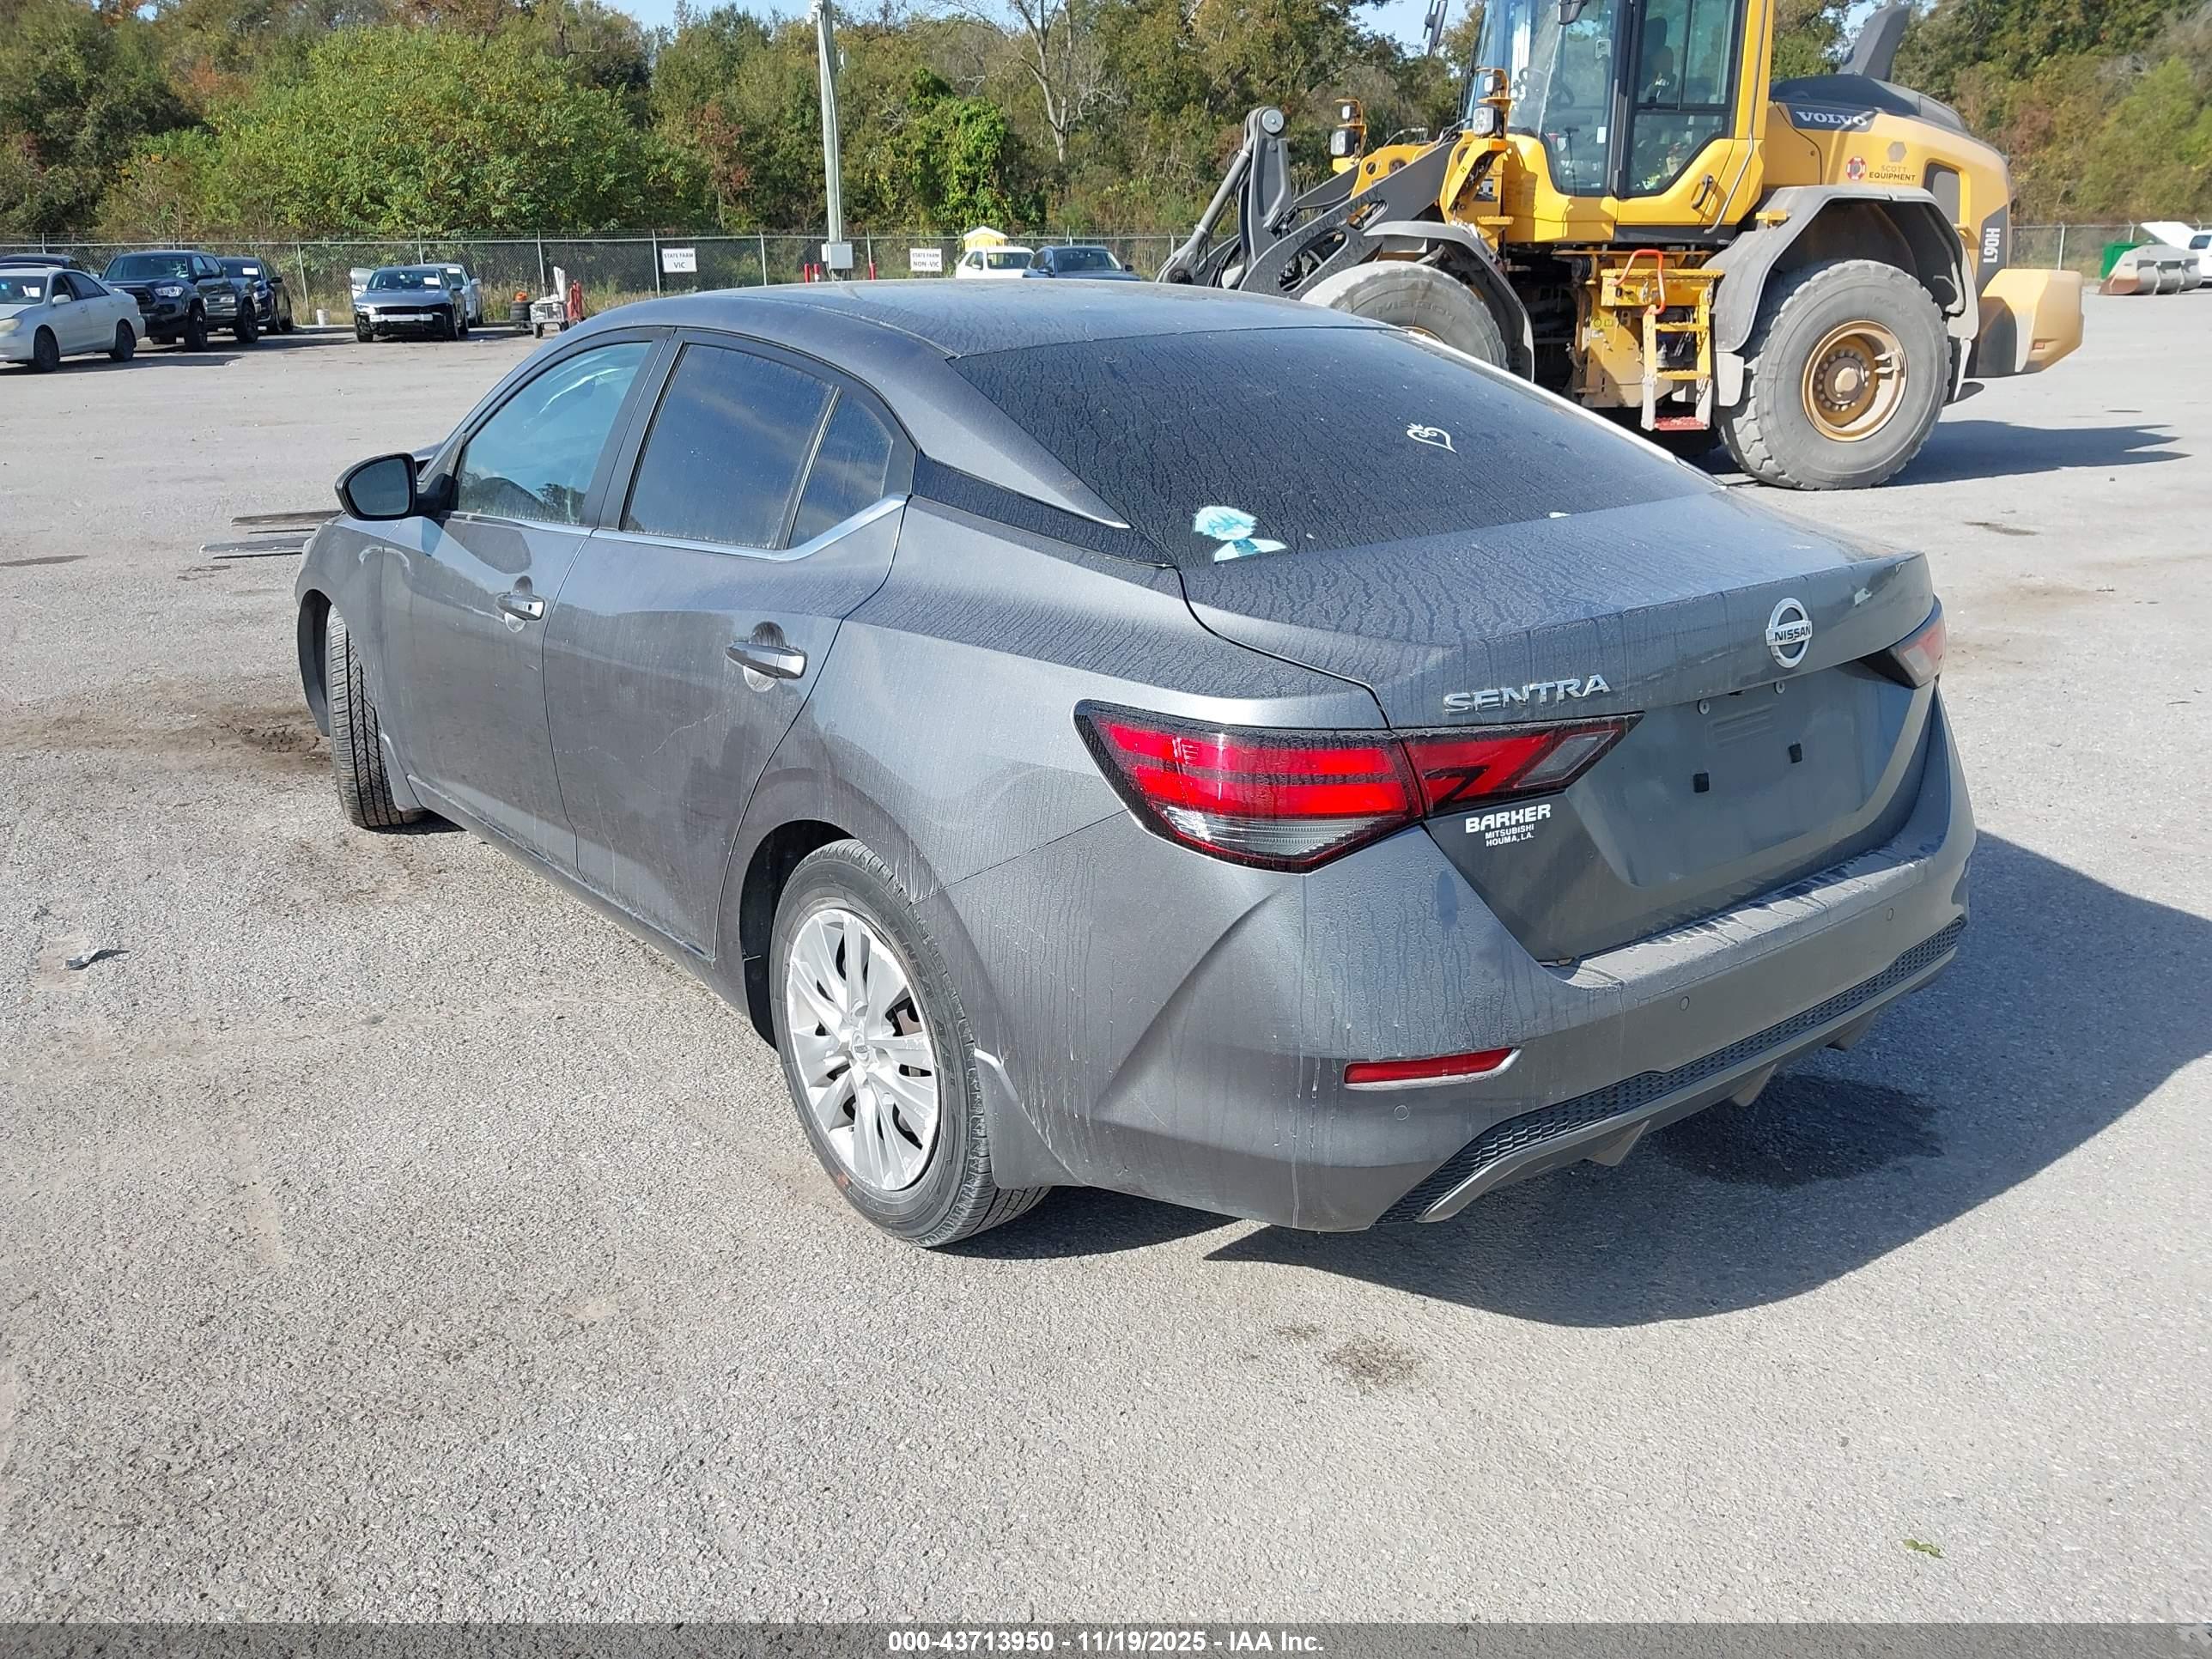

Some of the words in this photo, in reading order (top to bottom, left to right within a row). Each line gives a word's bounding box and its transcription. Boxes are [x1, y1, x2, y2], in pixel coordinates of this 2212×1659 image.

[1796, 111, 1868, 126] VOLVO
[1869, 172, 1917, 182] EQUIPMENT
[1881, 165, 1907, 173] SCOTT
[1317, 210, 1345, 234] NOT
[1983, 228, 2001, 263] L90H
[1774, 624, 1811, 642] NISSAN
[1443, 674, 1611, 715] SENTRA
[1465, 804, 1552, 834] BARKER
[1485, 823, 1534, 840] MITSUBISHI
[1486, 835, 1520, 848] HOUMA,
[1521, 831, 1534, 842] LA.
